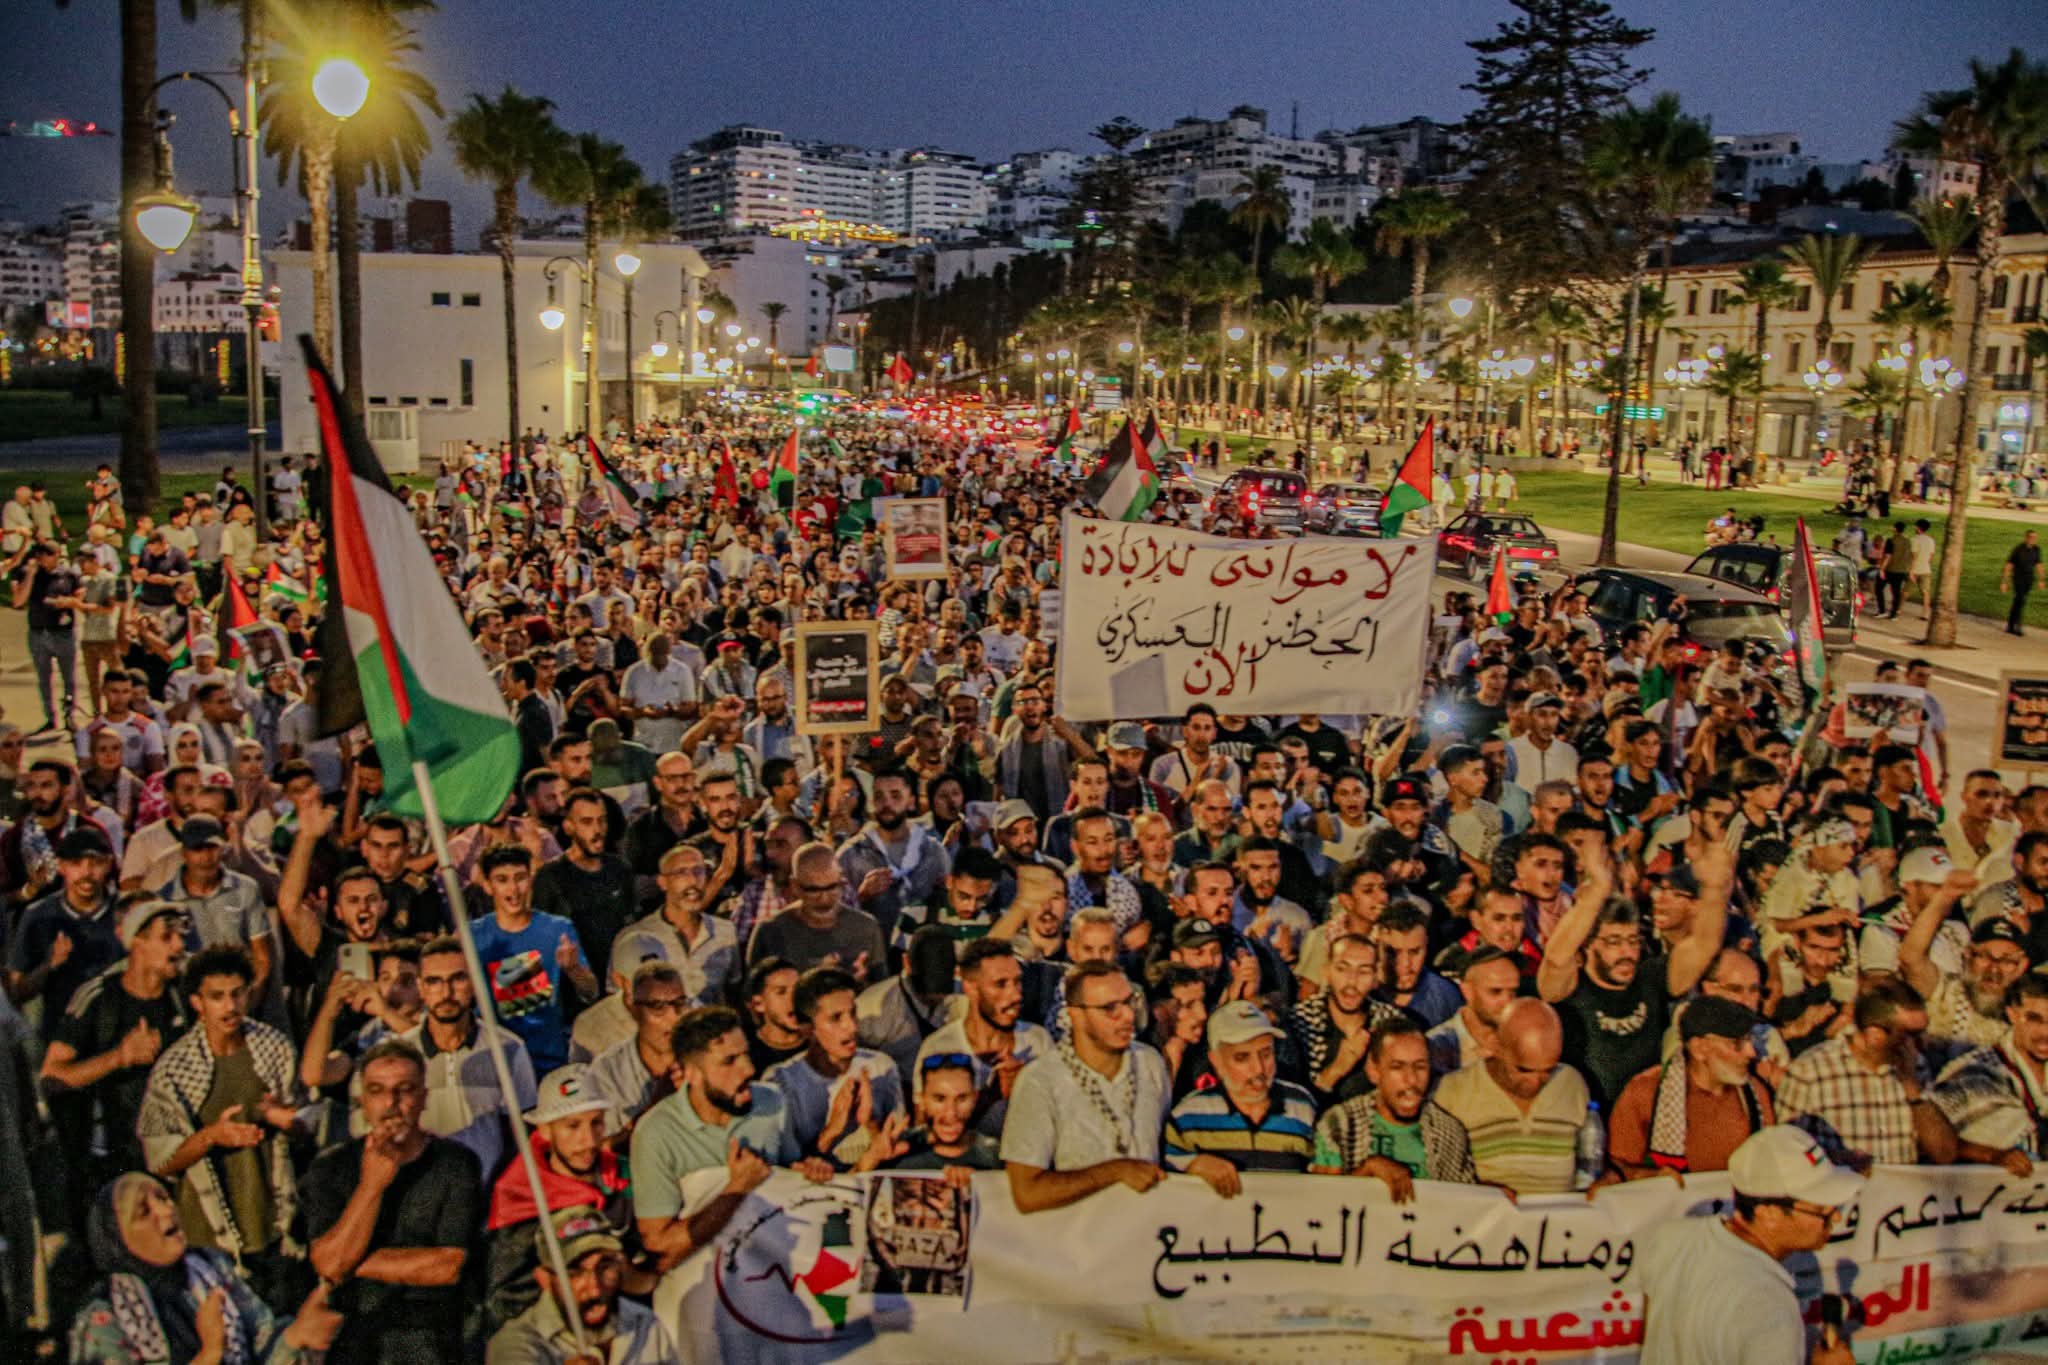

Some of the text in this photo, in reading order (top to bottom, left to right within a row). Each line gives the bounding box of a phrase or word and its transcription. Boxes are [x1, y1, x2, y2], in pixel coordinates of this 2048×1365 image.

[1364, 545, 1417, 599] لا
[1097, 595, 1232, 663] العسكري
[1153, 1201, 1367, 1298] التطبيع
[1386, 1210, 1634, 1284] ومناهضة
